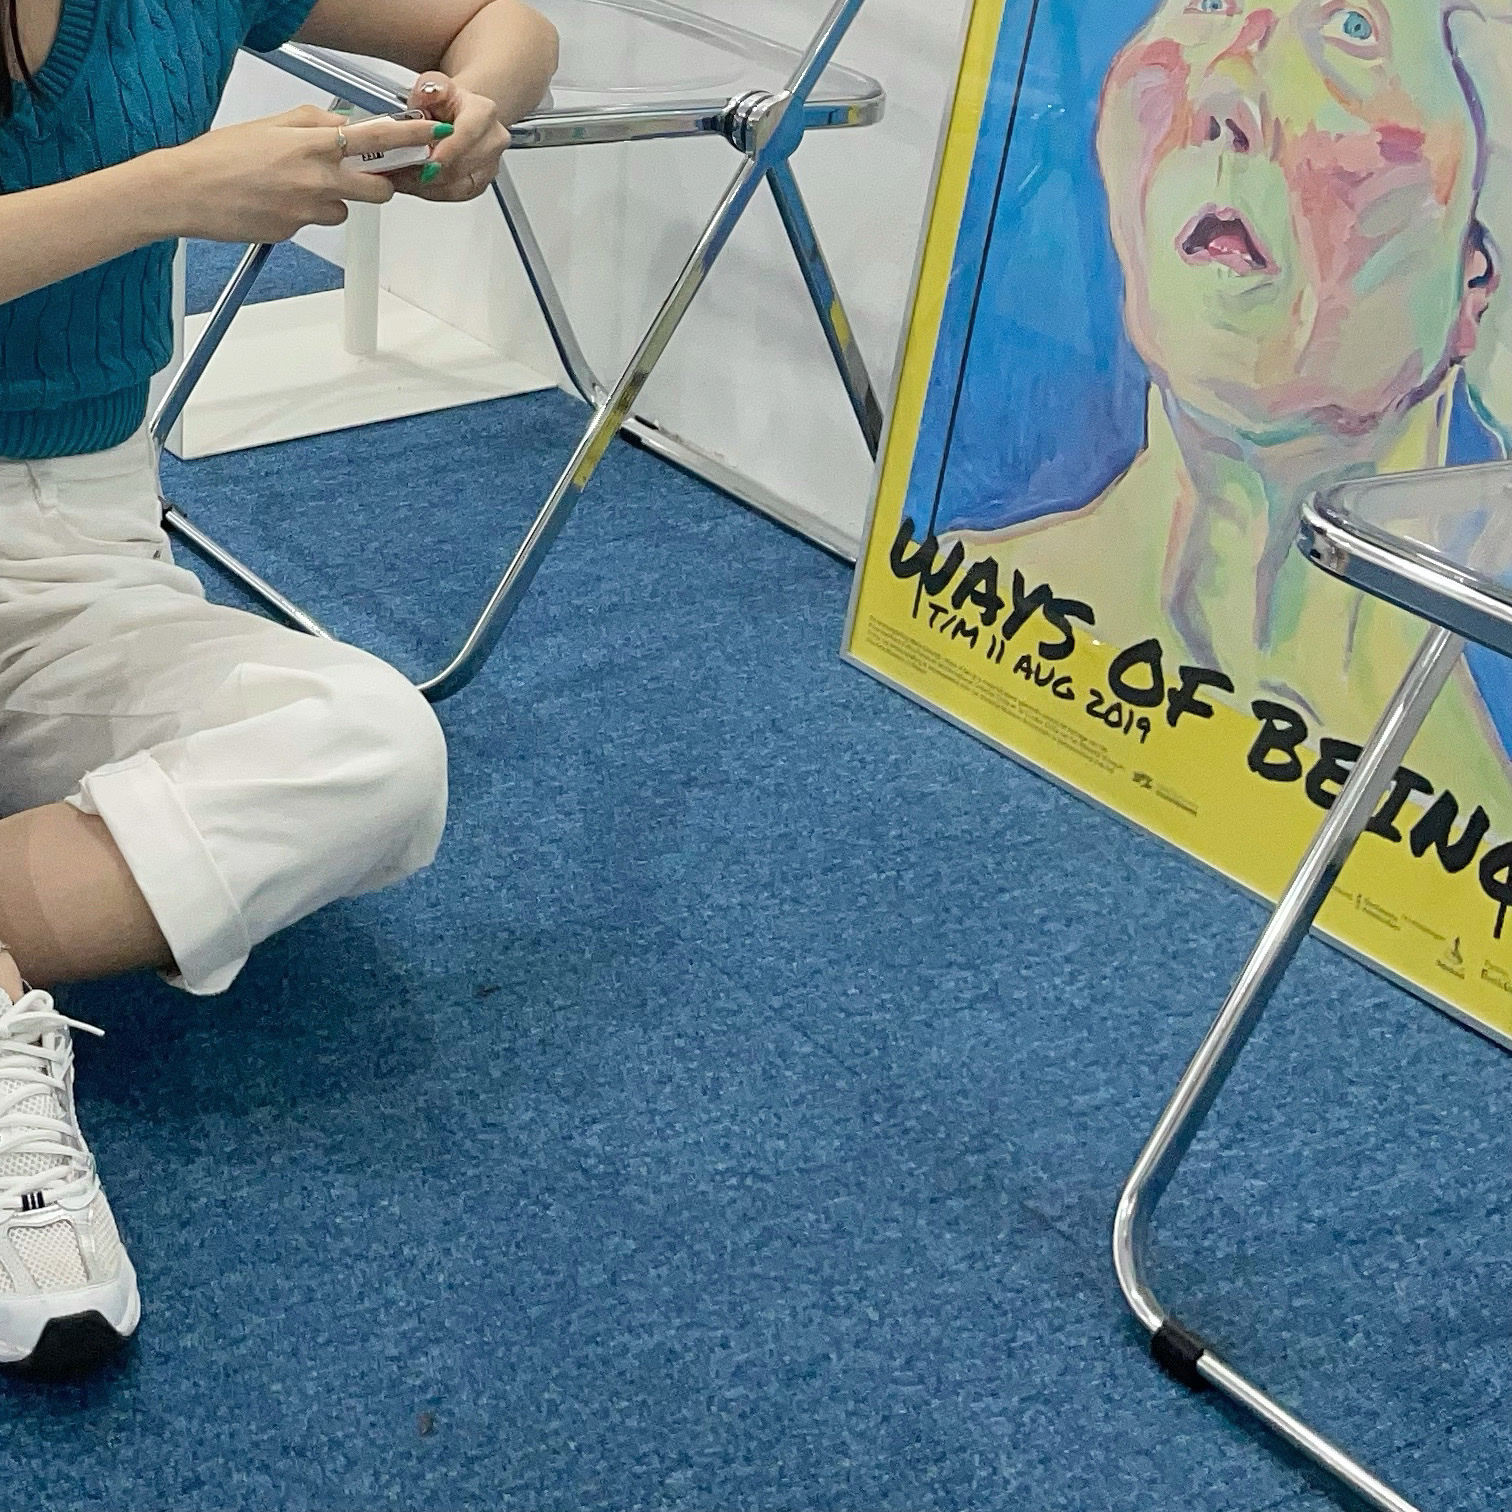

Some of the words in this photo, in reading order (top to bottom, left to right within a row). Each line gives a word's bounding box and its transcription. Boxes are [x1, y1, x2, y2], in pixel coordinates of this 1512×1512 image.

[890, 517, 1096, 660] WAYS
[1108, 639, 1235, 728] OF
[1013, 654, 1075, 700] AUG
[1085, 689, 1151, 744] 2019
